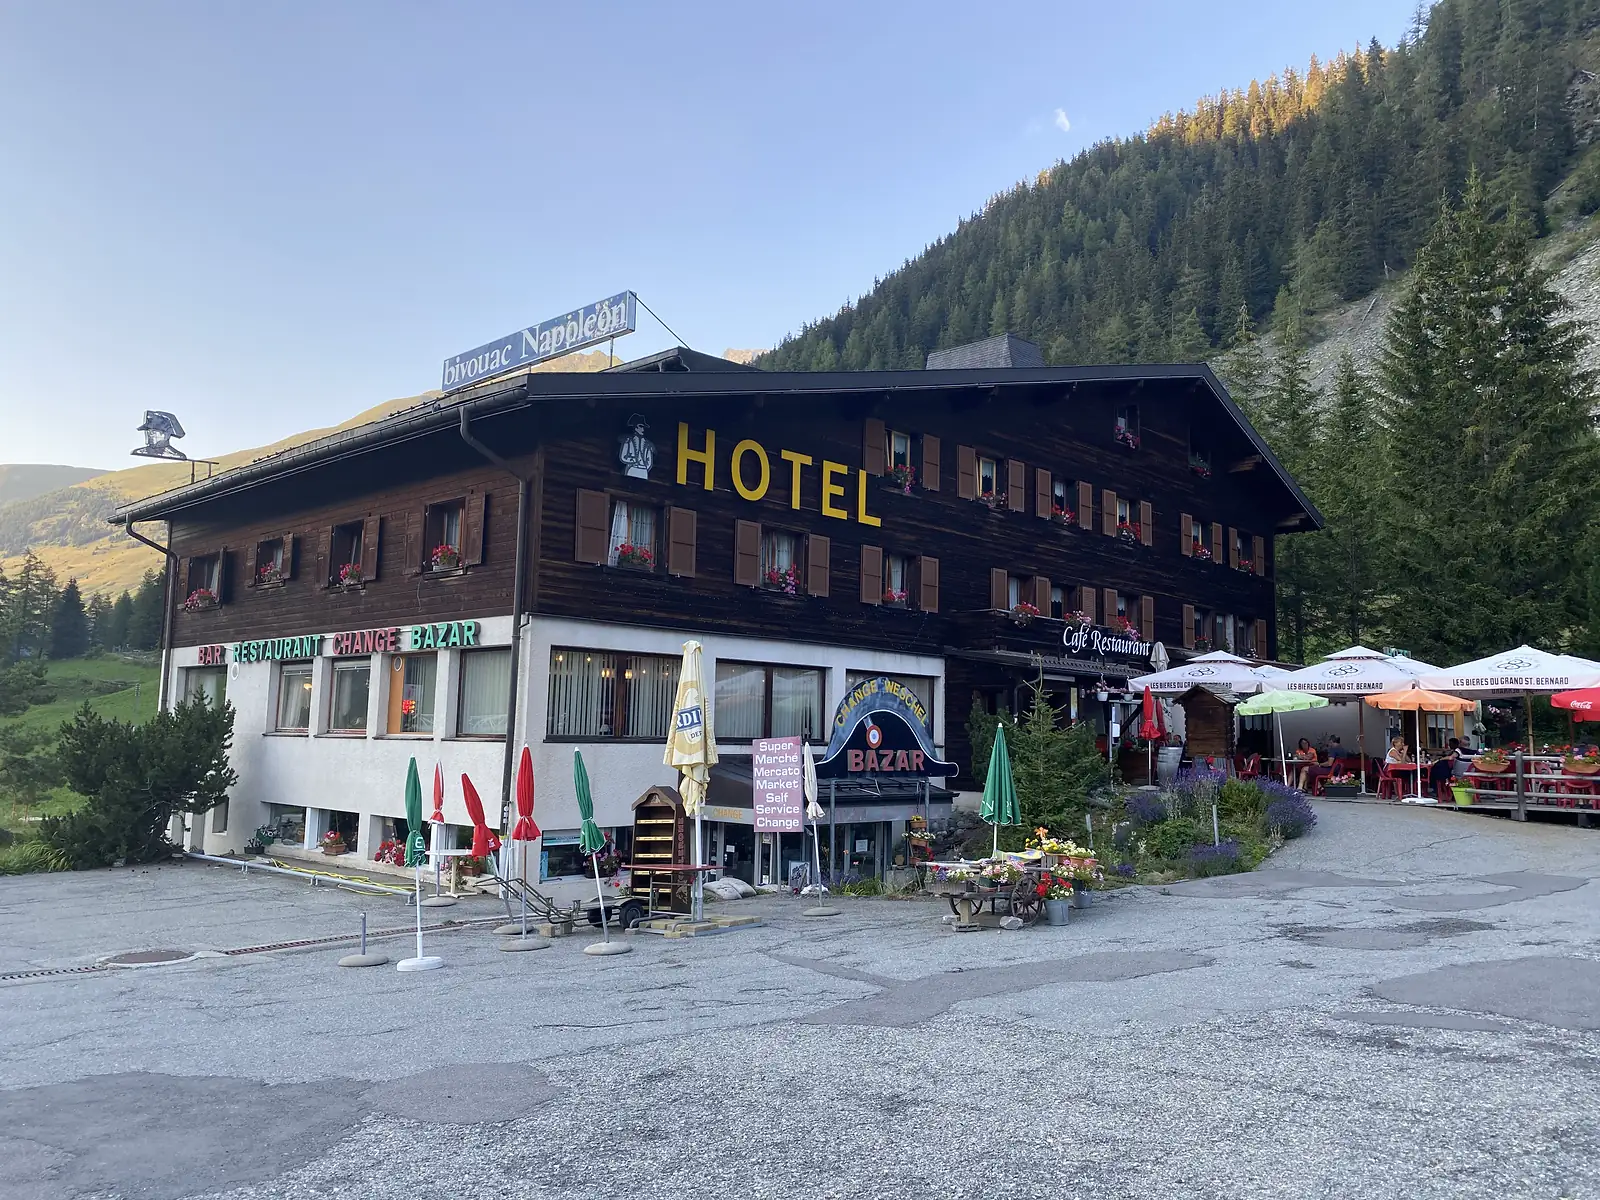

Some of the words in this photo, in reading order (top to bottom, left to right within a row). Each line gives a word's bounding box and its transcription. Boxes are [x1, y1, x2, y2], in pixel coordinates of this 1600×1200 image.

[444, 344, 512, 385] bivouac
[676, 421, 882, 528] HOTEL
[198, 645, 223, 665] BAR
[232, 635, 322, 663] RESTAURANT
[332, 628, 398, 655] CHANGE
[411, 621, 477, 649] BAZAR
[1063, 623, 1089, 653] Café
[1091, 630, 1151, 656] Restaurant
[1356, 682, 1383, 690] BERNARD
[1452, 678, 1464, 686] LES
[1490, 677, 1499, 686] DU
[1500, 677, 1523, 685] GRAND
[1536, 677, 1569, 685] BERNARD
[836, 680, 878, 727] CHANGE
[759, 741, 793, 753] Super
[755, 753, 798, 764] Marché
[847, 749, 925, 772] BAZAR
[754, 767, 800, 777] Mercato
[756, 779, 799, 790] Market
[766, 792, 789, 803] Self
[713, 807, 743, 819] CHANGE
[756, 804, 800, 814] Service
[756, 817, 799, 829] Change
